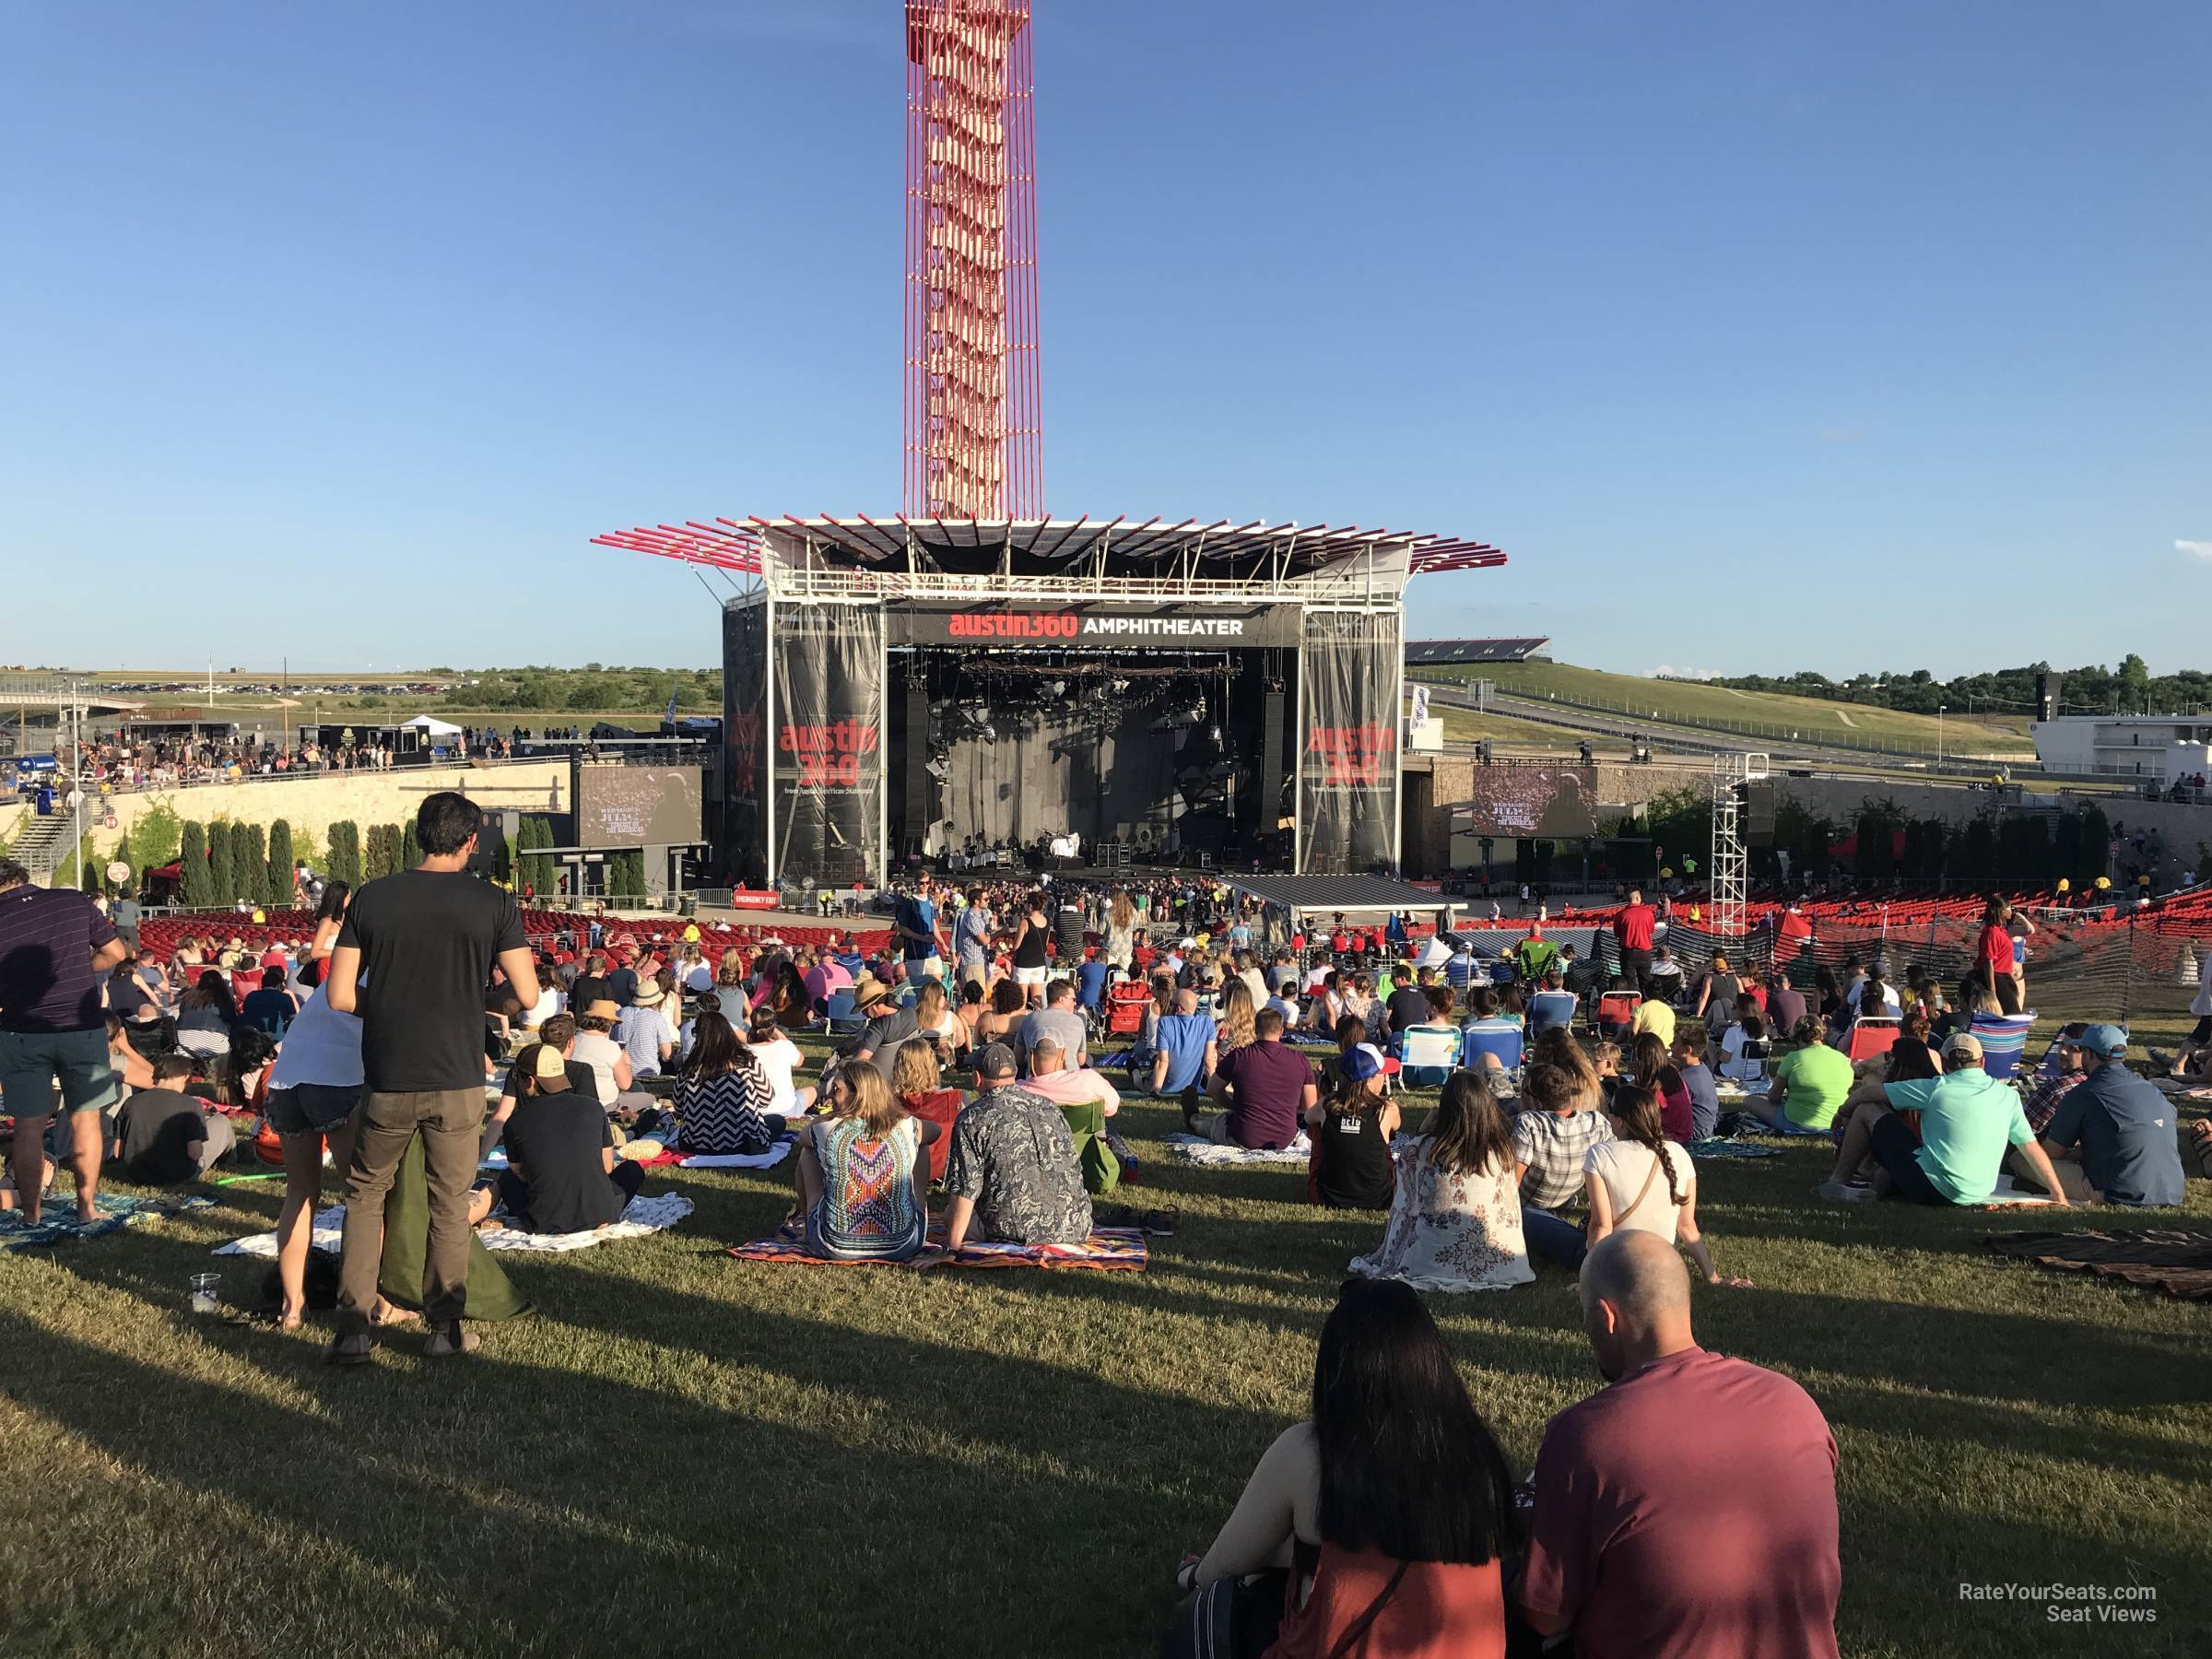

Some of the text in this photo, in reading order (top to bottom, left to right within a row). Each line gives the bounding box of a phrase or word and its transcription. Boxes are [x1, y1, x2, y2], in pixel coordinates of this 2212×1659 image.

[949, 611, 1243, 638] austin360 AMPHITHEATER
[780, 718, 876, 752] austin
[1309, 721, 1394, 752] austin
[799, 754, 858, 786] 360
[735, 895, 764, 903] EMERGENCY
